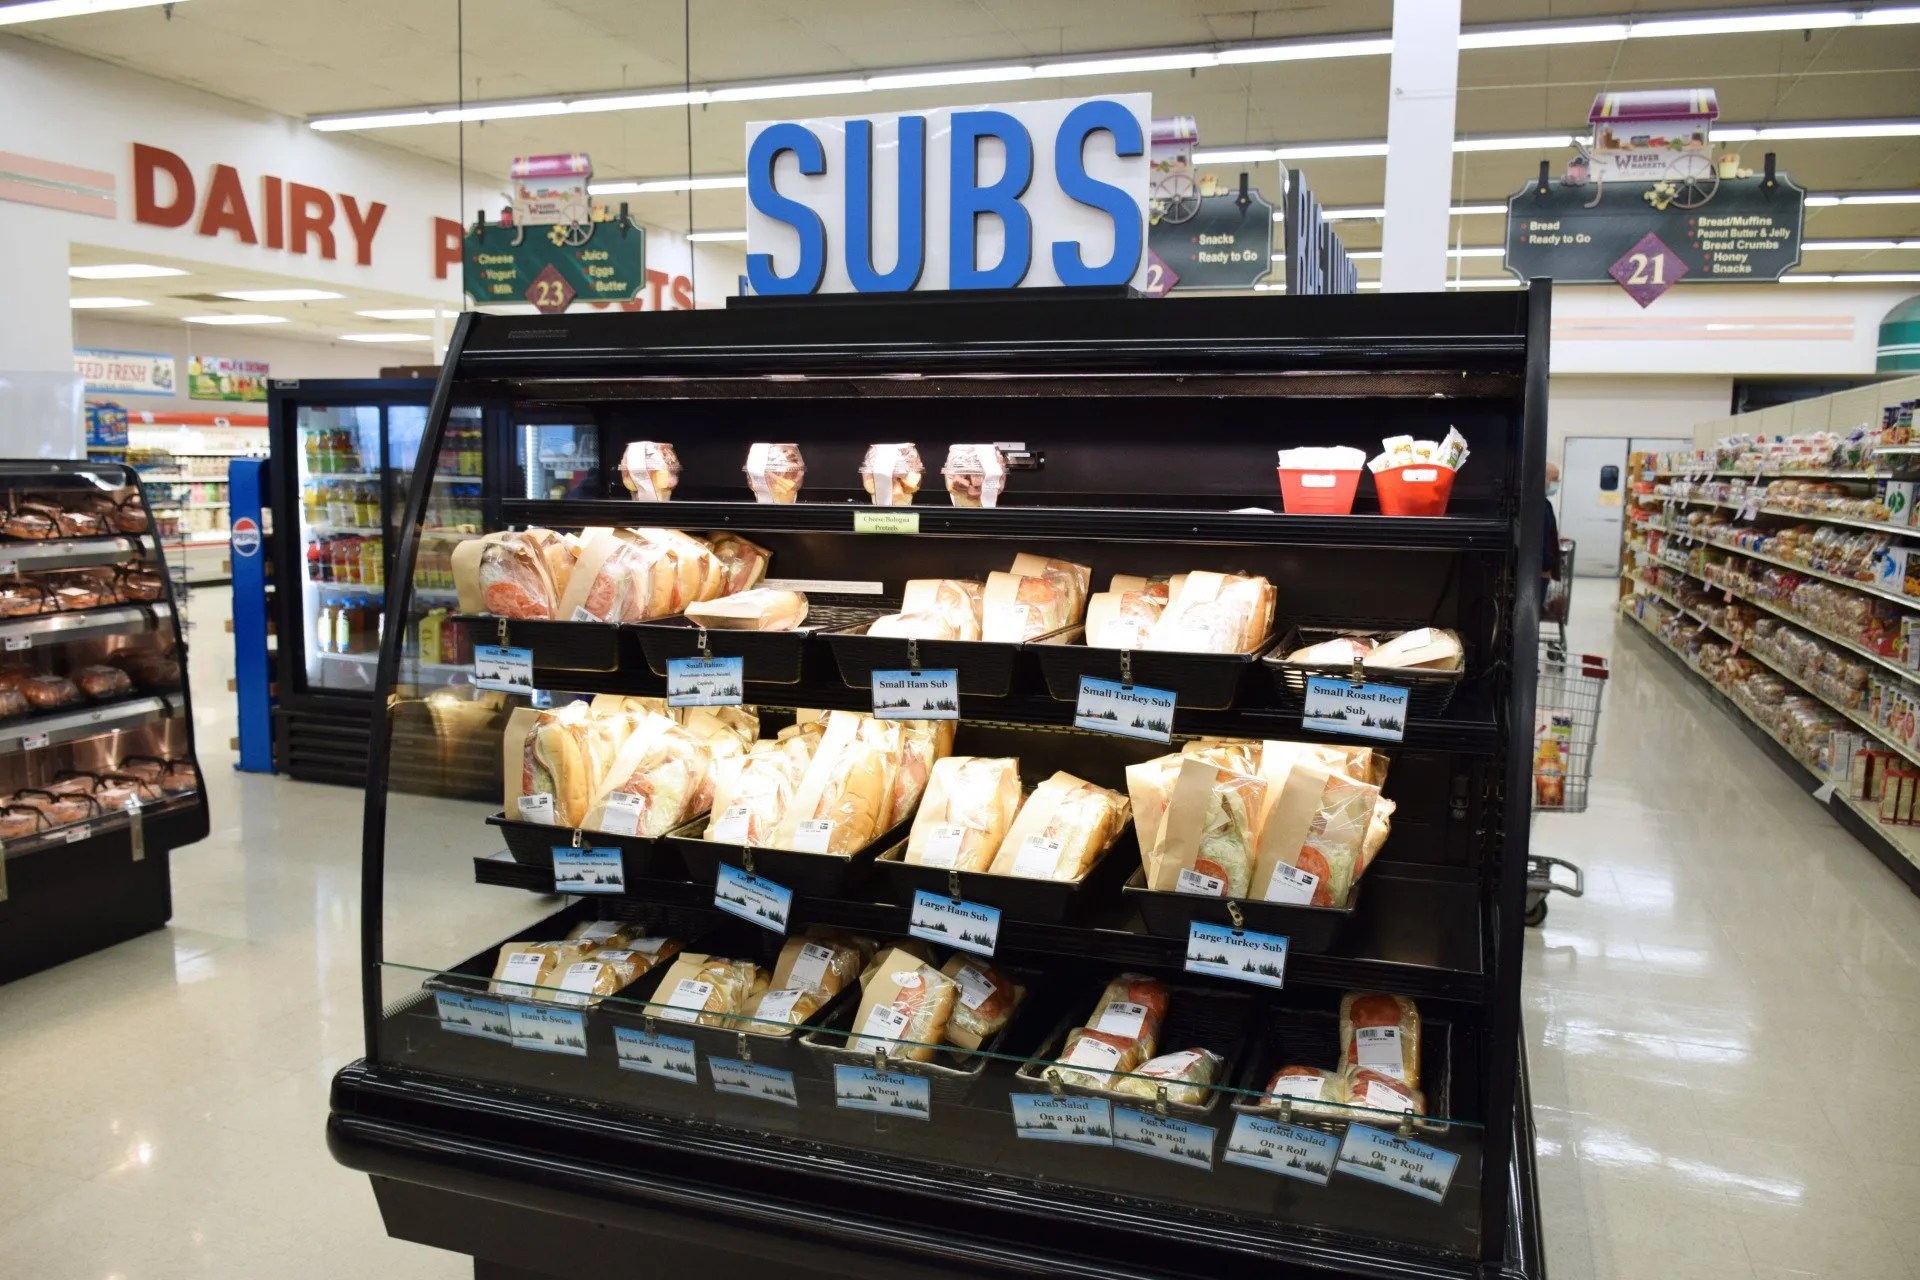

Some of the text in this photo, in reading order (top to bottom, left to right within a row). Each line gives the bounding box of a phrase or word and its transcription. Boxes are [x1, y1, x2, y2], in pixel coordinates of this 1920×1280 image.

[133, 142, 388, 266] DAIRY
[746, 100, 1144, 296] SUBS
[1530, 221, 1560, 231] Bread
[1698, 216, 1772, 227] Bread/Muffins
[1199, 233, 1234, 245] Snacks
[1529, 234, 1591, 245] Ready to Go
[1697, 228, 1791, 239] Peanut Butter & Jelly
[1702, 240, 1779, 250] Bread Crumbs
[478, 254, 514, 265] Cheese
[581, 251, 608, 261] Juice
[1199, 250, 1258, 264] Ready to Go
[1713, 251, 1748, 263] Honey
[486, 269, 516, 281] Yogurt
[588, 266, 614, 278] Eggs
[1627, 253, 1666, 284] 21
[1712, 264, 1752, 273] Snacks
[1147, 264, 1164, 292] 2
[595, 281, 627, 292] Butter
[536, 281, 565, 306] 23
[930, 680, 948, 688] Sub
[1083, 686, 1171, 708] Small Turkey Sub
[1314, 686, 1404, 704] Small Roast Beef
[1345, 706, 1366, 715] Sub
[920, 898, 988, 922] Large Ham Sub
[1193, 930, 1282, 953] Large Turkey Sub
[439, 999, 458, 1008] Ham
[467, 1004, 504, 1017] American
[521, 1012, 540, 1021] Ham
[549, 1016, 573, 1025] Swiss
[618, 1036, 638, 1045] Roast
[639, 1038, 654, 1047] Beef
[661, 1043, 691, 1054] Cheddar
[713, 1063, 740, 1074] Turkey
[747, 1070, 786, 1082] Provolone
[861, 1073, 905, 1085] Assorted
[867, 1085, 899, 1097] Wheat
[1033, 1099, 1089, 1110] Krab Salad
[1039, 1113, 1055, 1121] On
[1066, 1114, 1086, 1123] Roll
[1140, 1116, 1188, 1133] Egg Salad
[1140, 1128, 1155, 1137] On
[1165, 1133, 1186, 1144] Roll
[1249, 1122, 1327, 1147] Seafood Salad
[1259, 1139, 1275, 1149] On
[1285, 1143, 1307, 1156] Roll
[1371, 1134, 1435, 1160] Tuna Salad
[1371, 1150, 1424, 1173] On a Roll
